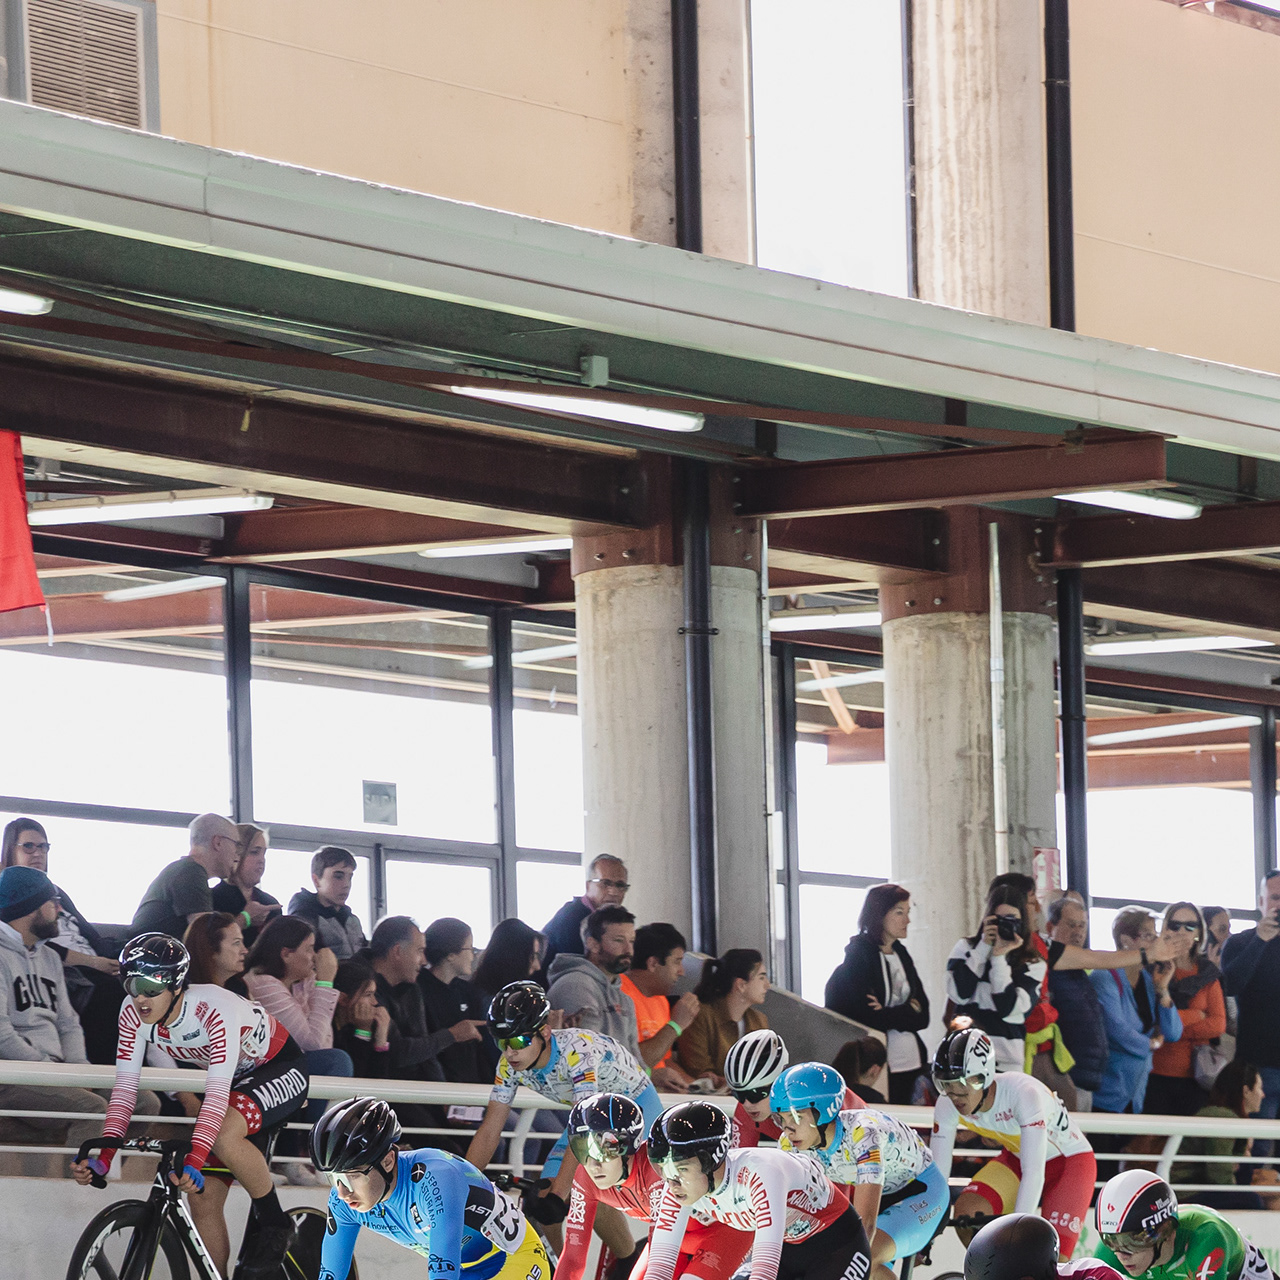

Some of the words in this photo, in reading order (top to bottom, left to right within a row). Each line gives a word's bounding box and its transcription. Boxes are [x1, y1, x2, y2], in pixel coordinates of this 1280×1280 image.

[252, 1067, 308, 1111] MADRID
[425, 1170, 445, 1216] DEPORTE
[464, 1203, 491, 1217] AST
